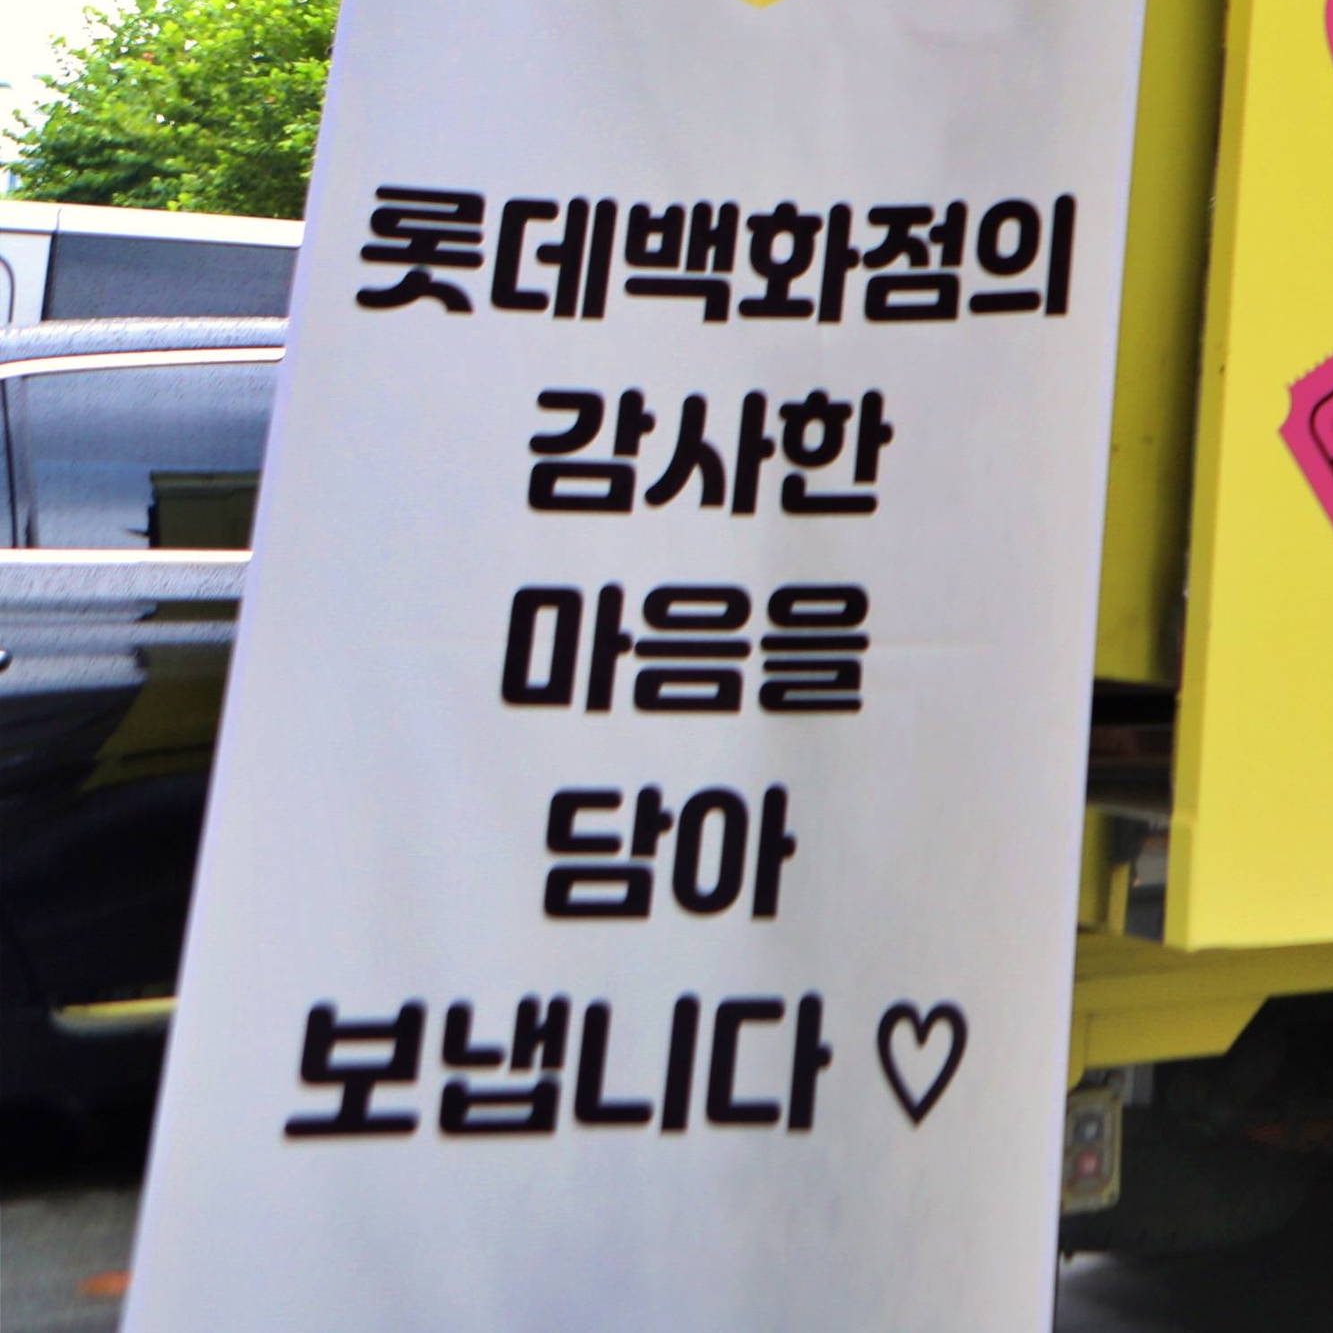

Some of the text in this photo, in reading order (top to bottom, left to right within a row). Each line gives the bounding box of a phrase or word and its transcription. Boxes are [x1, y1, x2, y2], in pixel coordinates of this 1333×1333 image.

[355, 186, 1077, 324] 롯데백화점의
[527, 388, 894, 516] 감사한
[500, 583, 870, 715] 마음을
[543, 784, 797, 920] 담아
[283, 992, 833, 1140] 보냅니다
